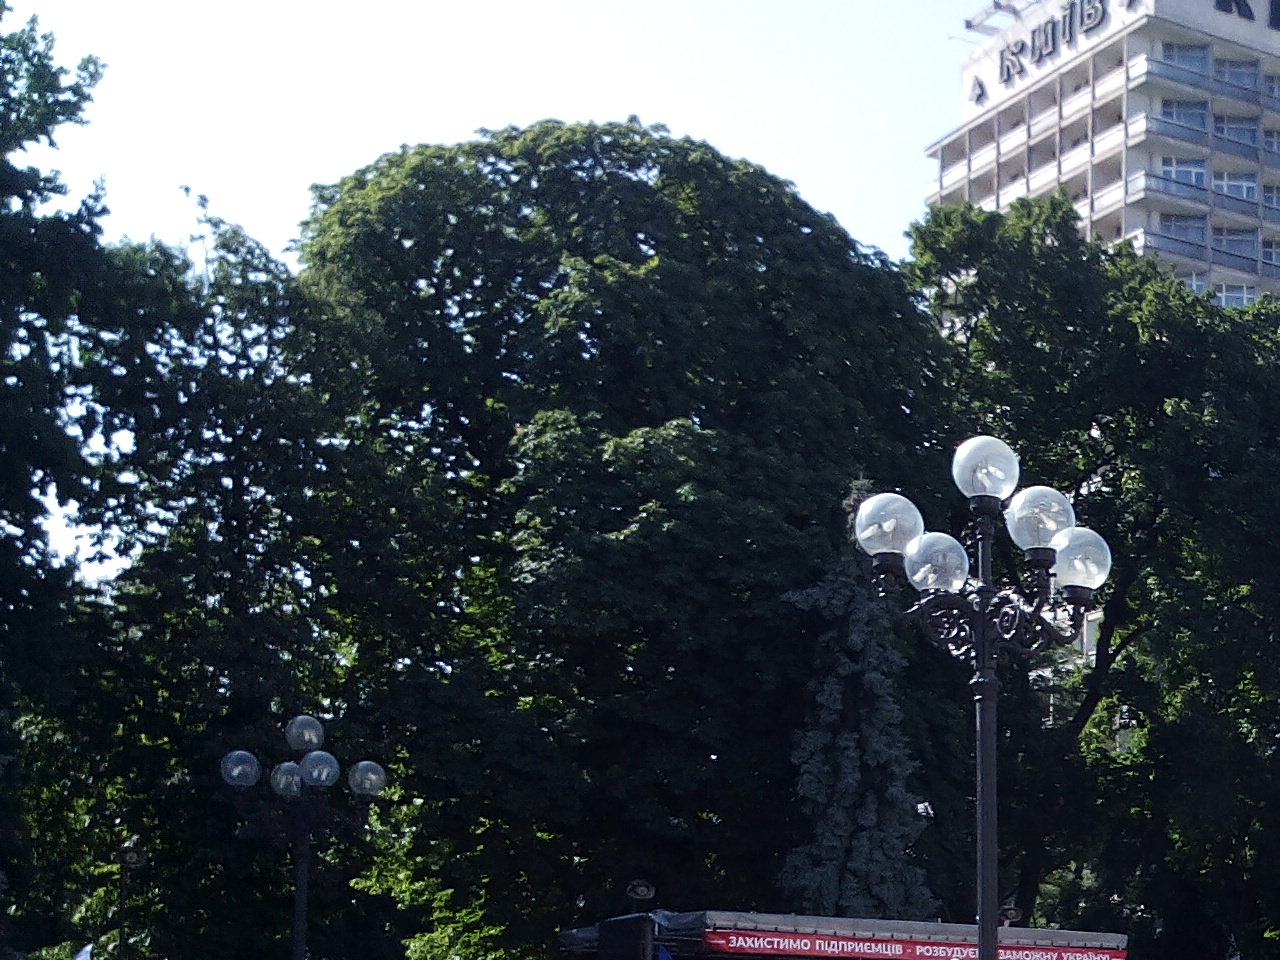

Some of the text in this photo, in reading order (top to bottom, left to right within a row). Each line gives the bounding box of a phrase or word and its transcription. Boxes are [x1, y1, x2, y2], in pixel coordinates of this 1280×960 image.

[729, 935, 811, 951] ЗАХИСТИМО
[816, 939, 903, 956] ПІДПРИЄМЦІВ
[916, 945, 978, 960] РОЗБУДУЄ
